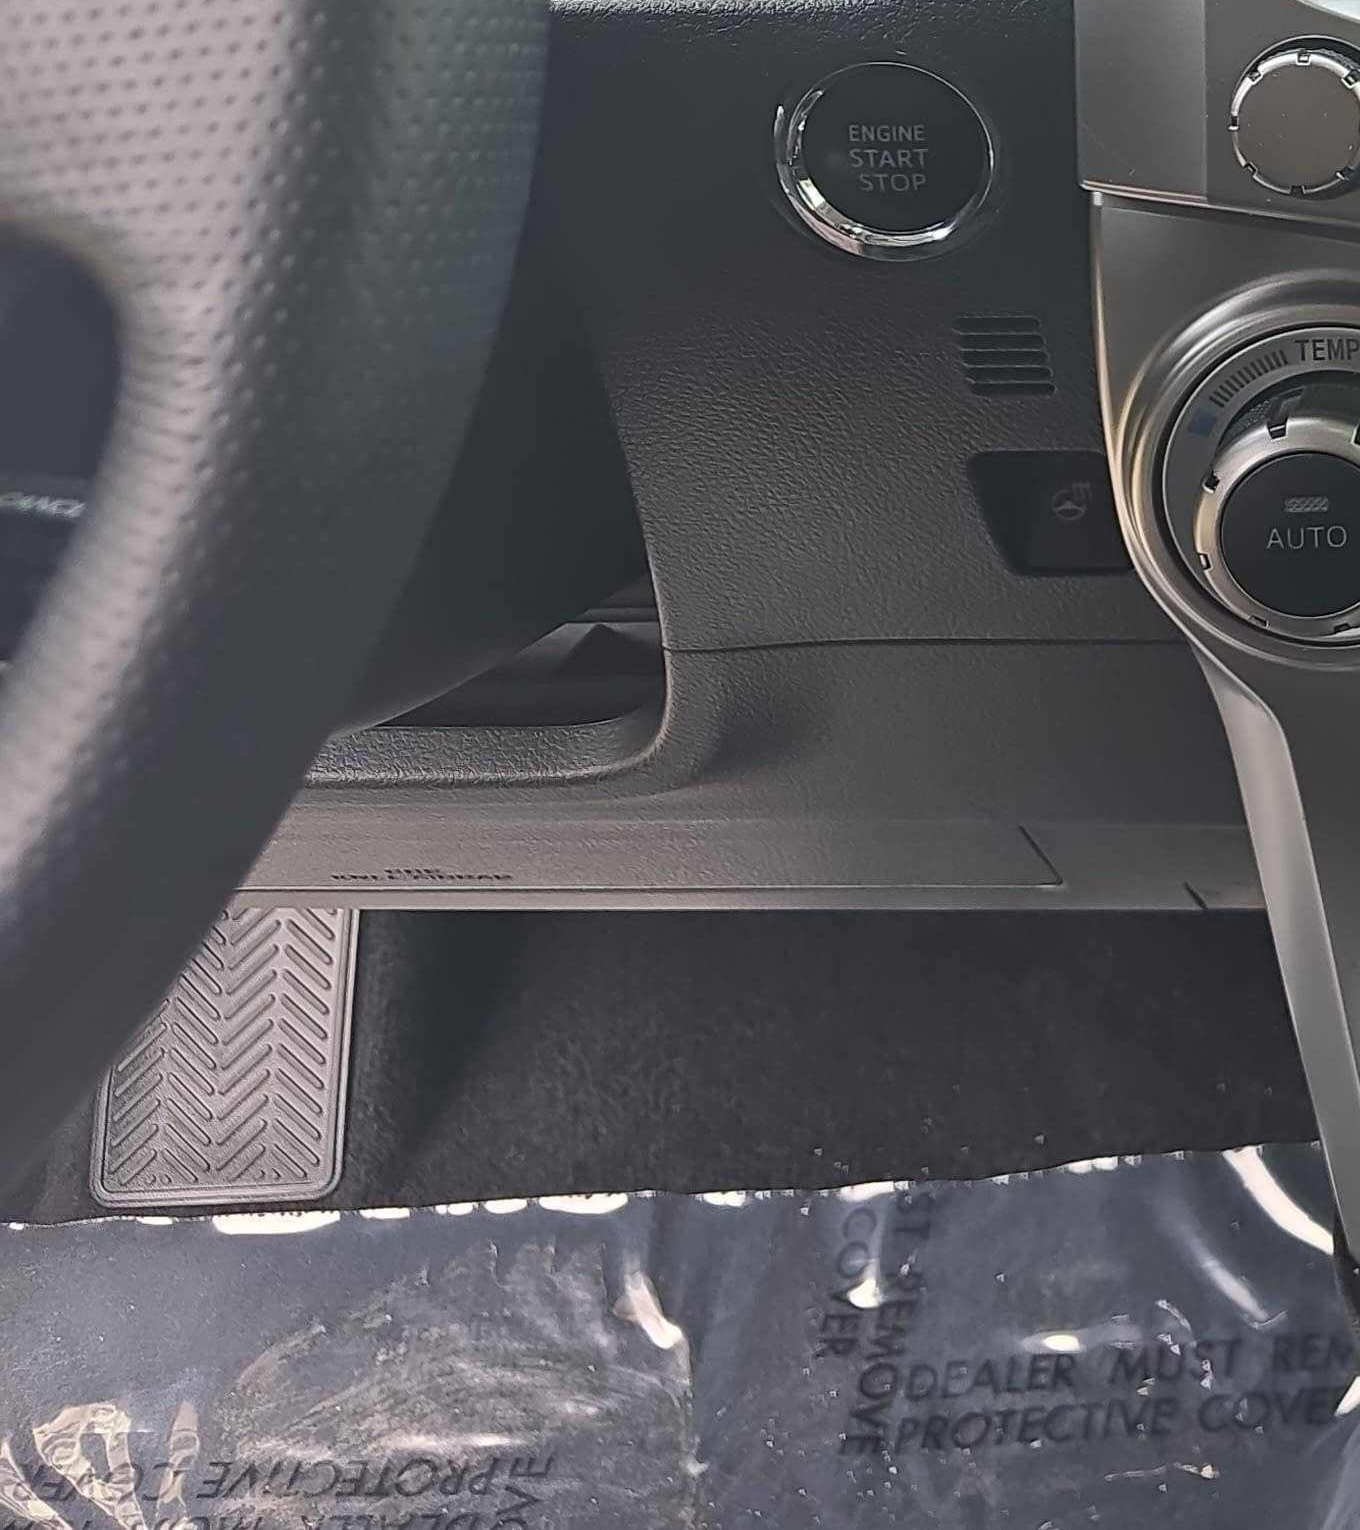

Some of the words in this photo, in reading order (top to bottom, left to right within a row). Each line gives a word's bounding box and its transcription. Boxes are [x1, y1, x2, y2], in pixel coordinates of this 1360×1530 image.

[848, 124, 925, 143] ENGINE
[849, 148, 929, 169] START
[857, 173, 926, 192] STOP
[1293, 338, 1360, 362] TEMP
[1266, 525, 1347, 550] AUTO
[903, 1351, 1077, 1402] DEALER
[898, 1394, 1178, 1450] PROTECTIVE
[1198, 1384, 1348, 1433] COVE
[196, 1457, 506, 1499] PROTECTIVE
